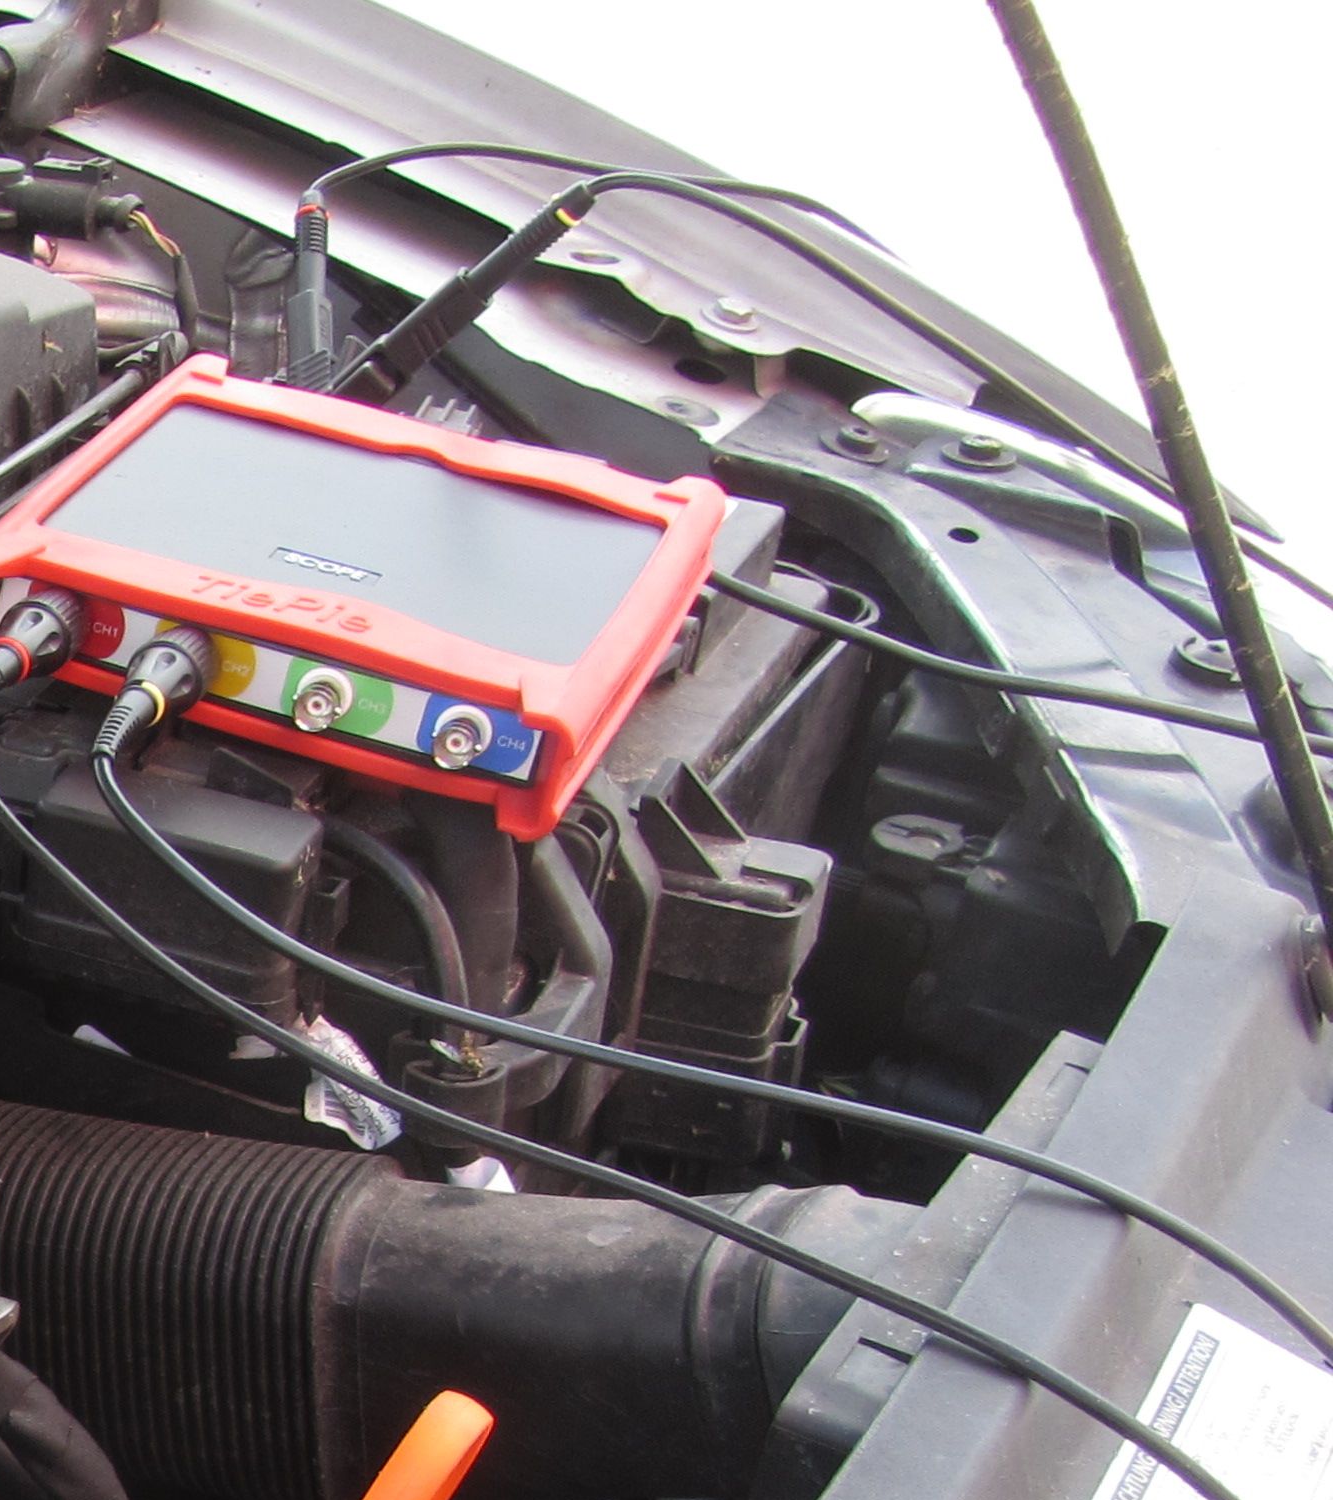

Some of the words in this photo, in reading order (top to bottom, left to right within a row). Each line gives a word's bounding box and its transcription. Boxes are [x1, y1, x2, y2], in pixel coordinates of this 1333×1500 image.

[283, 552, 369, 583] SCOPE
[92, 621, 118, 637] CH1
[496, 734, 526, 751] CH4
[1170, 1332, 1217, 1398] ATTENTION!
